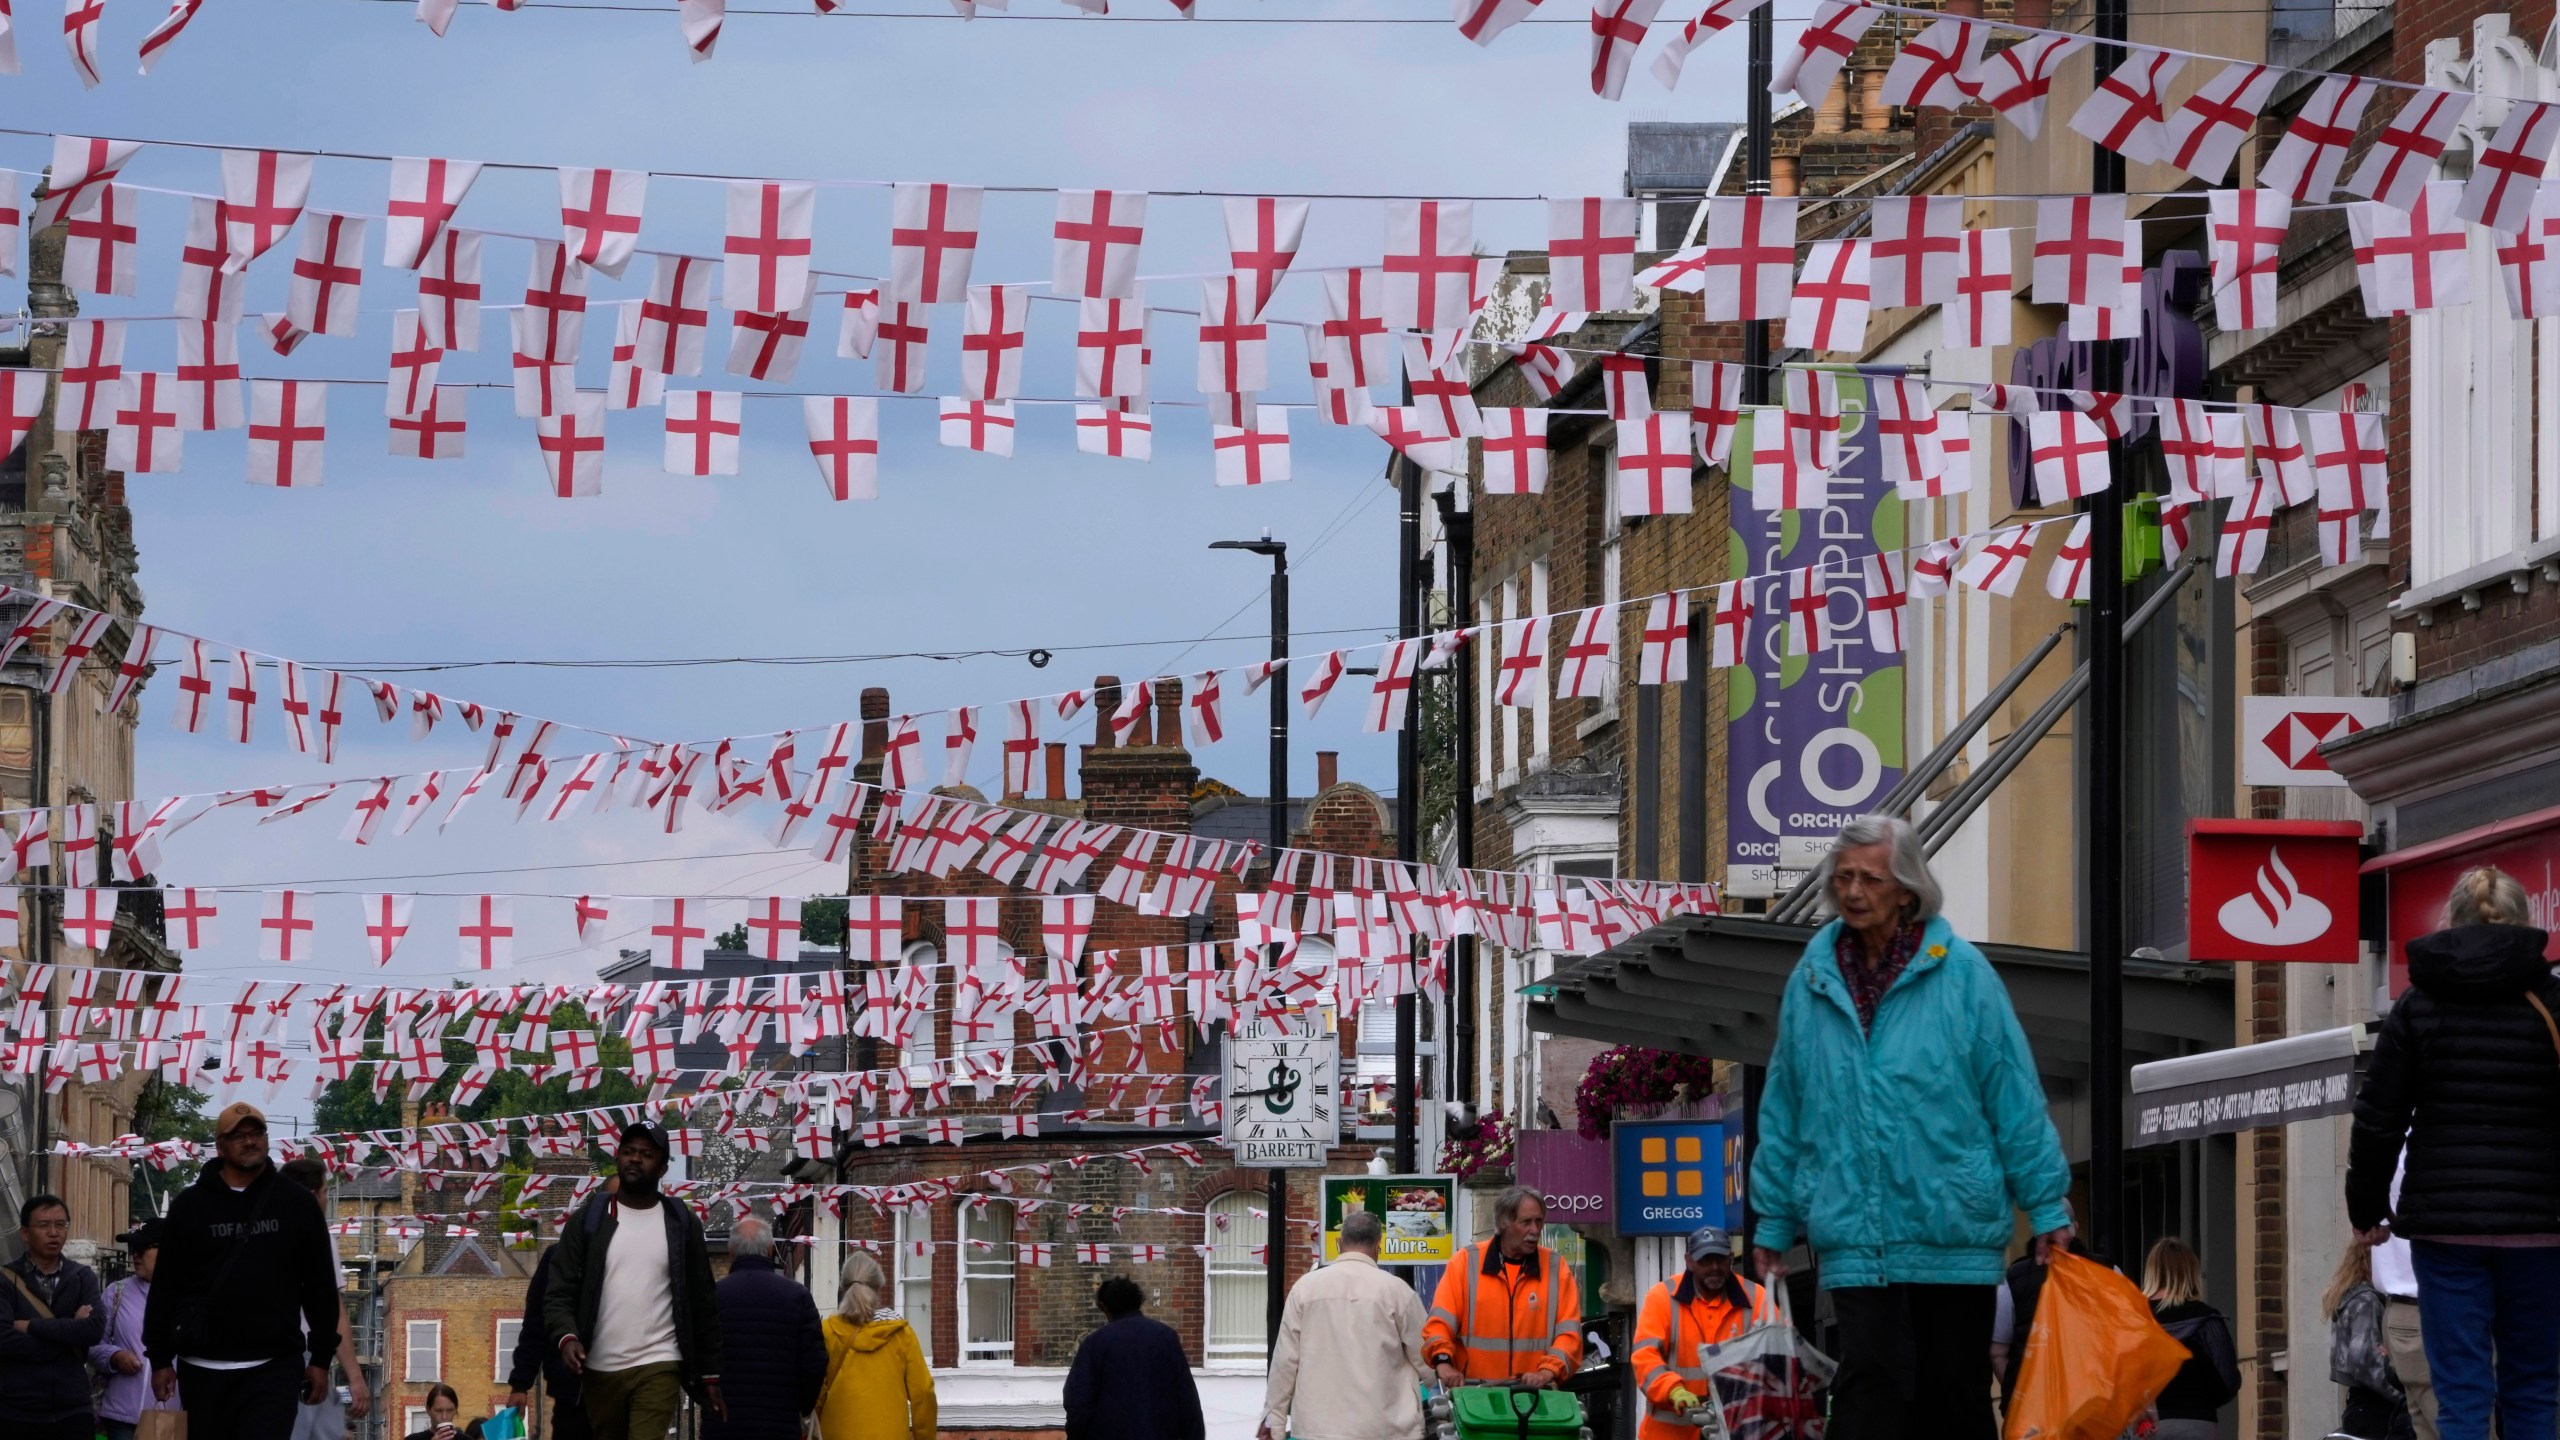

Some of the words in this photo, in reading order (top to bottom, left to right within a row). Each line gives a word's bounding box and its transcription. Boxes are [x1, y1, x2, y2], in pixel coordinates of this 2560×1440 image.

[2222, 1093, 2238, 1120] HOT
[2297, 1079, 2322, 1108] SALADS
[1246, 1143, 1316, 1160] BARRETT
[1543, 1194, 1603, 1214] cope
[1643, 1206, 1703, 1220] GREGGS
[208, 1218, 279, 1238] TOFAONO
